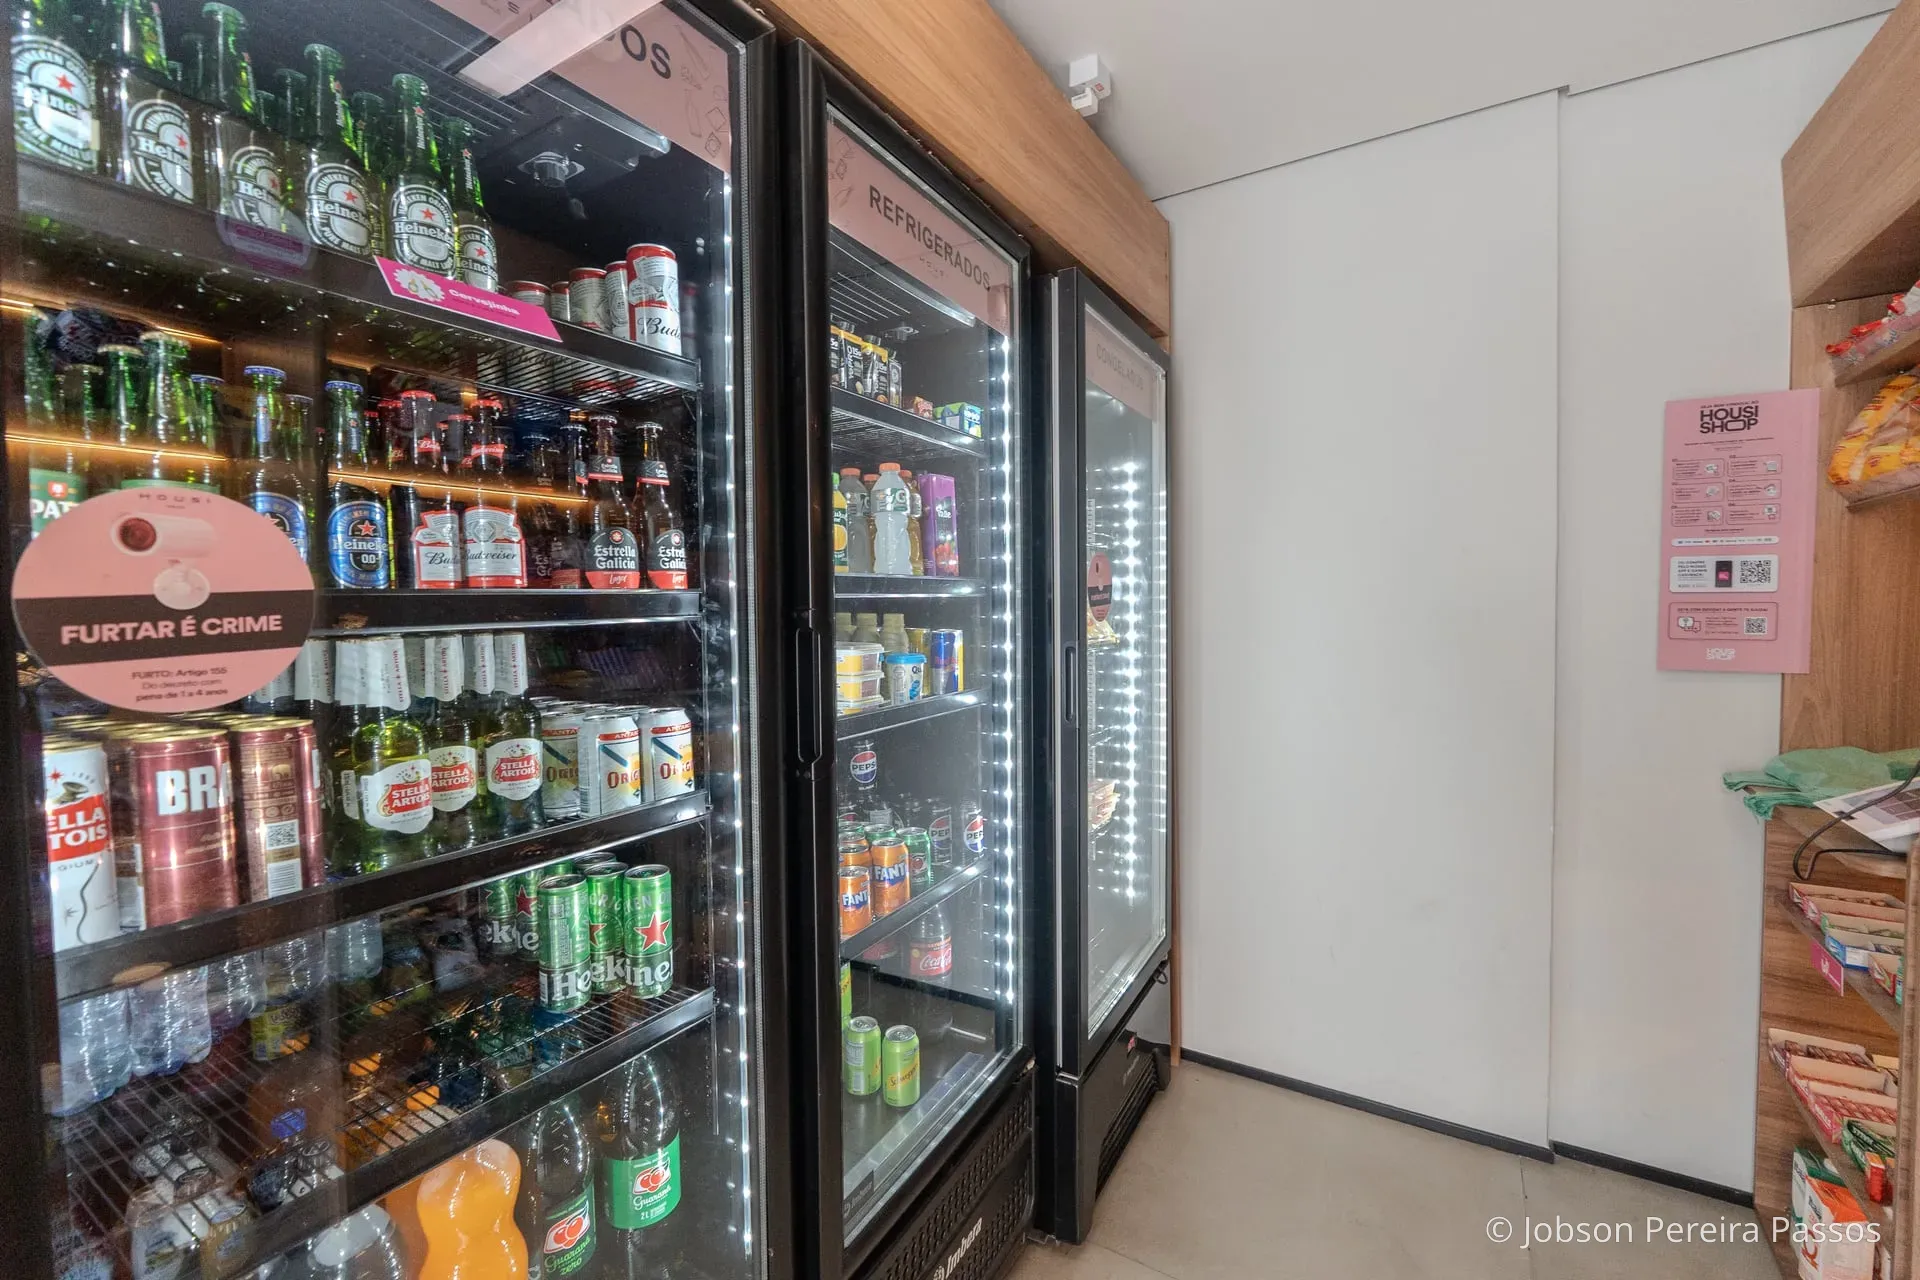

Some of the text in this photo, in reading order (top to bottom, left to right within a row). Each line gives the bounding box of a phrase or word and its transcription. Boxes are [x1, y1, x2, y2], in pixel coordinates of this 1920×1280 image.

[869, 184, 991, 292] REFRIGERADOS
[1700, 405, 1759, 422] HOUSI
[1699, 418, 1758, 434] SHOP
[594, 545, 636, 558] Estrella
[595, 557, 636, 570] Galicia
[60, 614, 283, 645] FURTAR É CRIME
[131, 670, 174, 680] FURTO:
[175, 669, 208, 677] Artigo
[135, 694, 162, 702] pena
[500, 759, 535, 770] STELLA
[431, 767, 469, 780] STELLA
[501, 767, 536, 777] ARTOIS
[431, 777, 469, 788] ARTOIS
[391, 784, 430, 799] STELLA
[391, 794, 430, 808] ARTOIS
